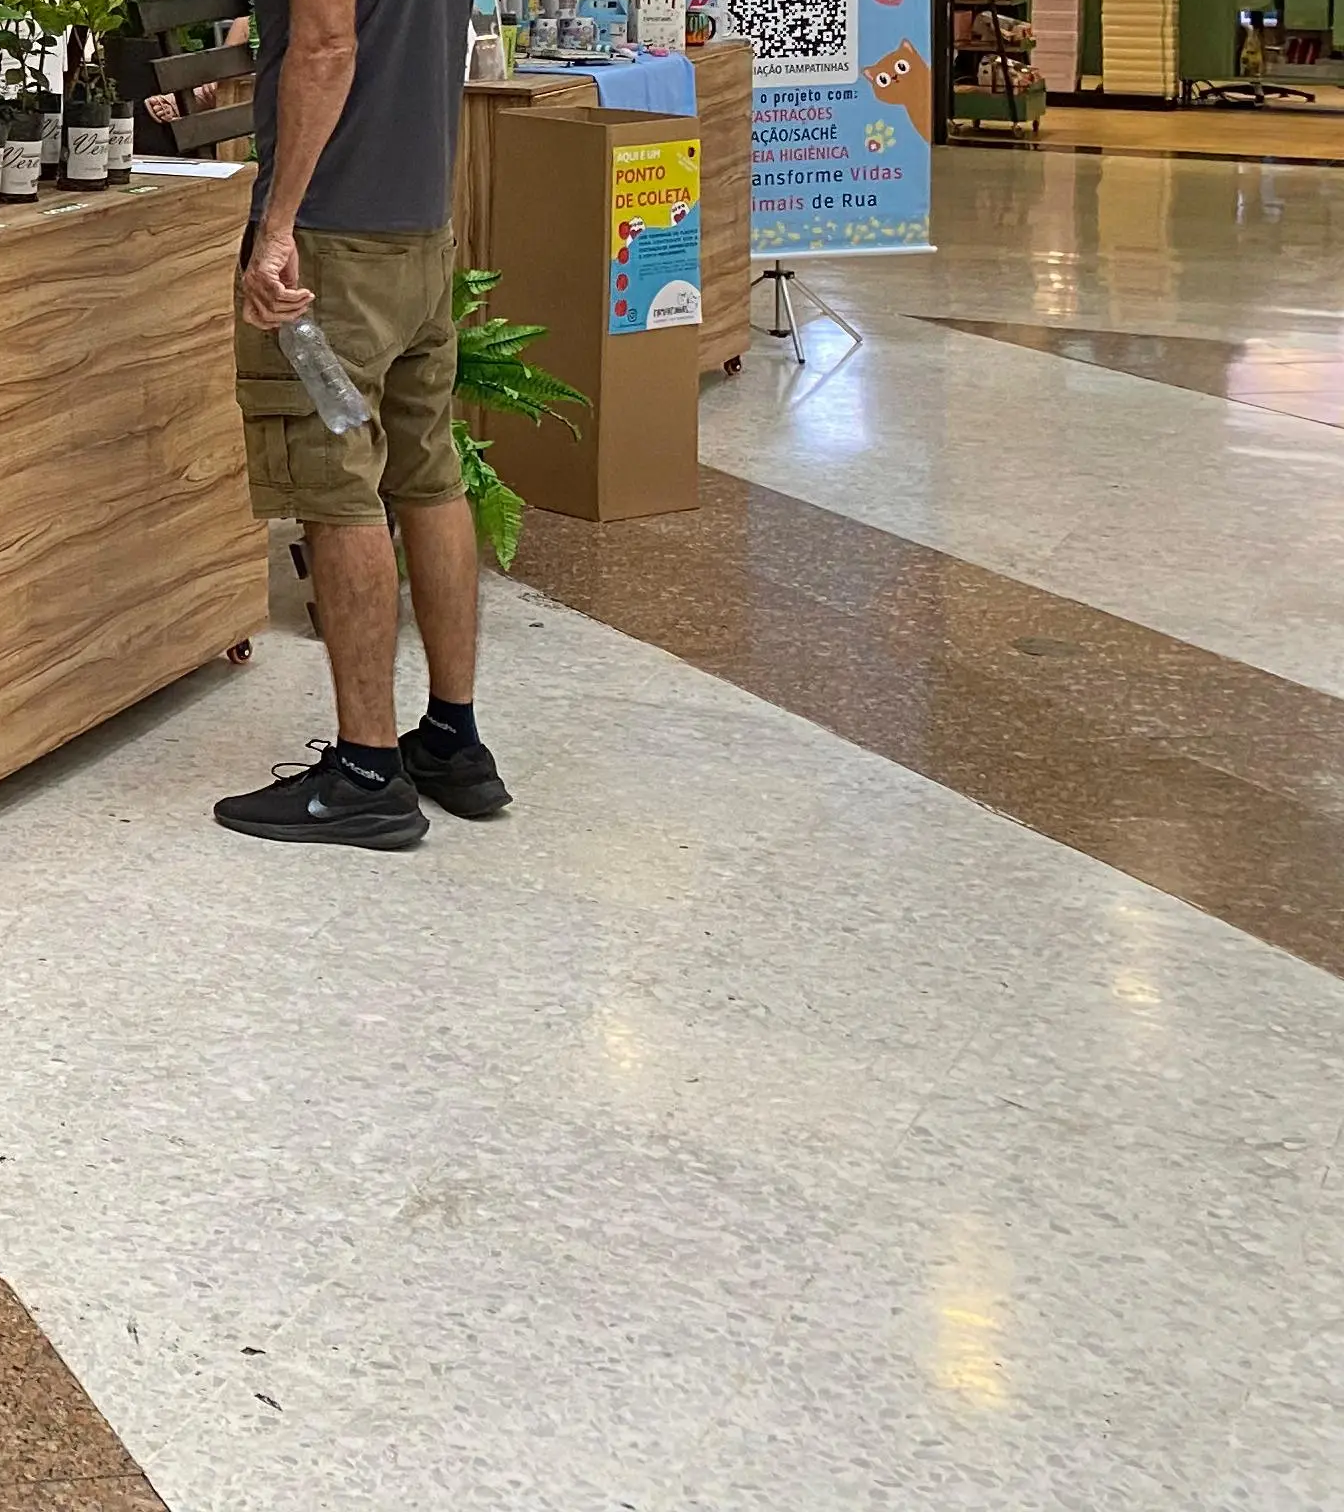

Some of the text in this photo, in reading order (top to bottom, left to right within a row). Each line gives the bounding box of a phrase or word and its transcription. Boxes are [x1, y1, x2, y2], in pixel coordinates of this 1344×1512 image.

[785, 61, 850, 75] TAMPATINHAS
[760, 89, 859, 108] o projeto com:
[752, 123, 838, 147] AÇÃO/SACHÊ
[752, 145, 850, 164] EIA HIGIÊNICA
[616, 165, 666, 185] PONTO
[752, 164, 904, 187] ansforme Vidas
[615, 187, 692, 209] DE COLETA
[752, 192, 878, 212] imais de Rua
